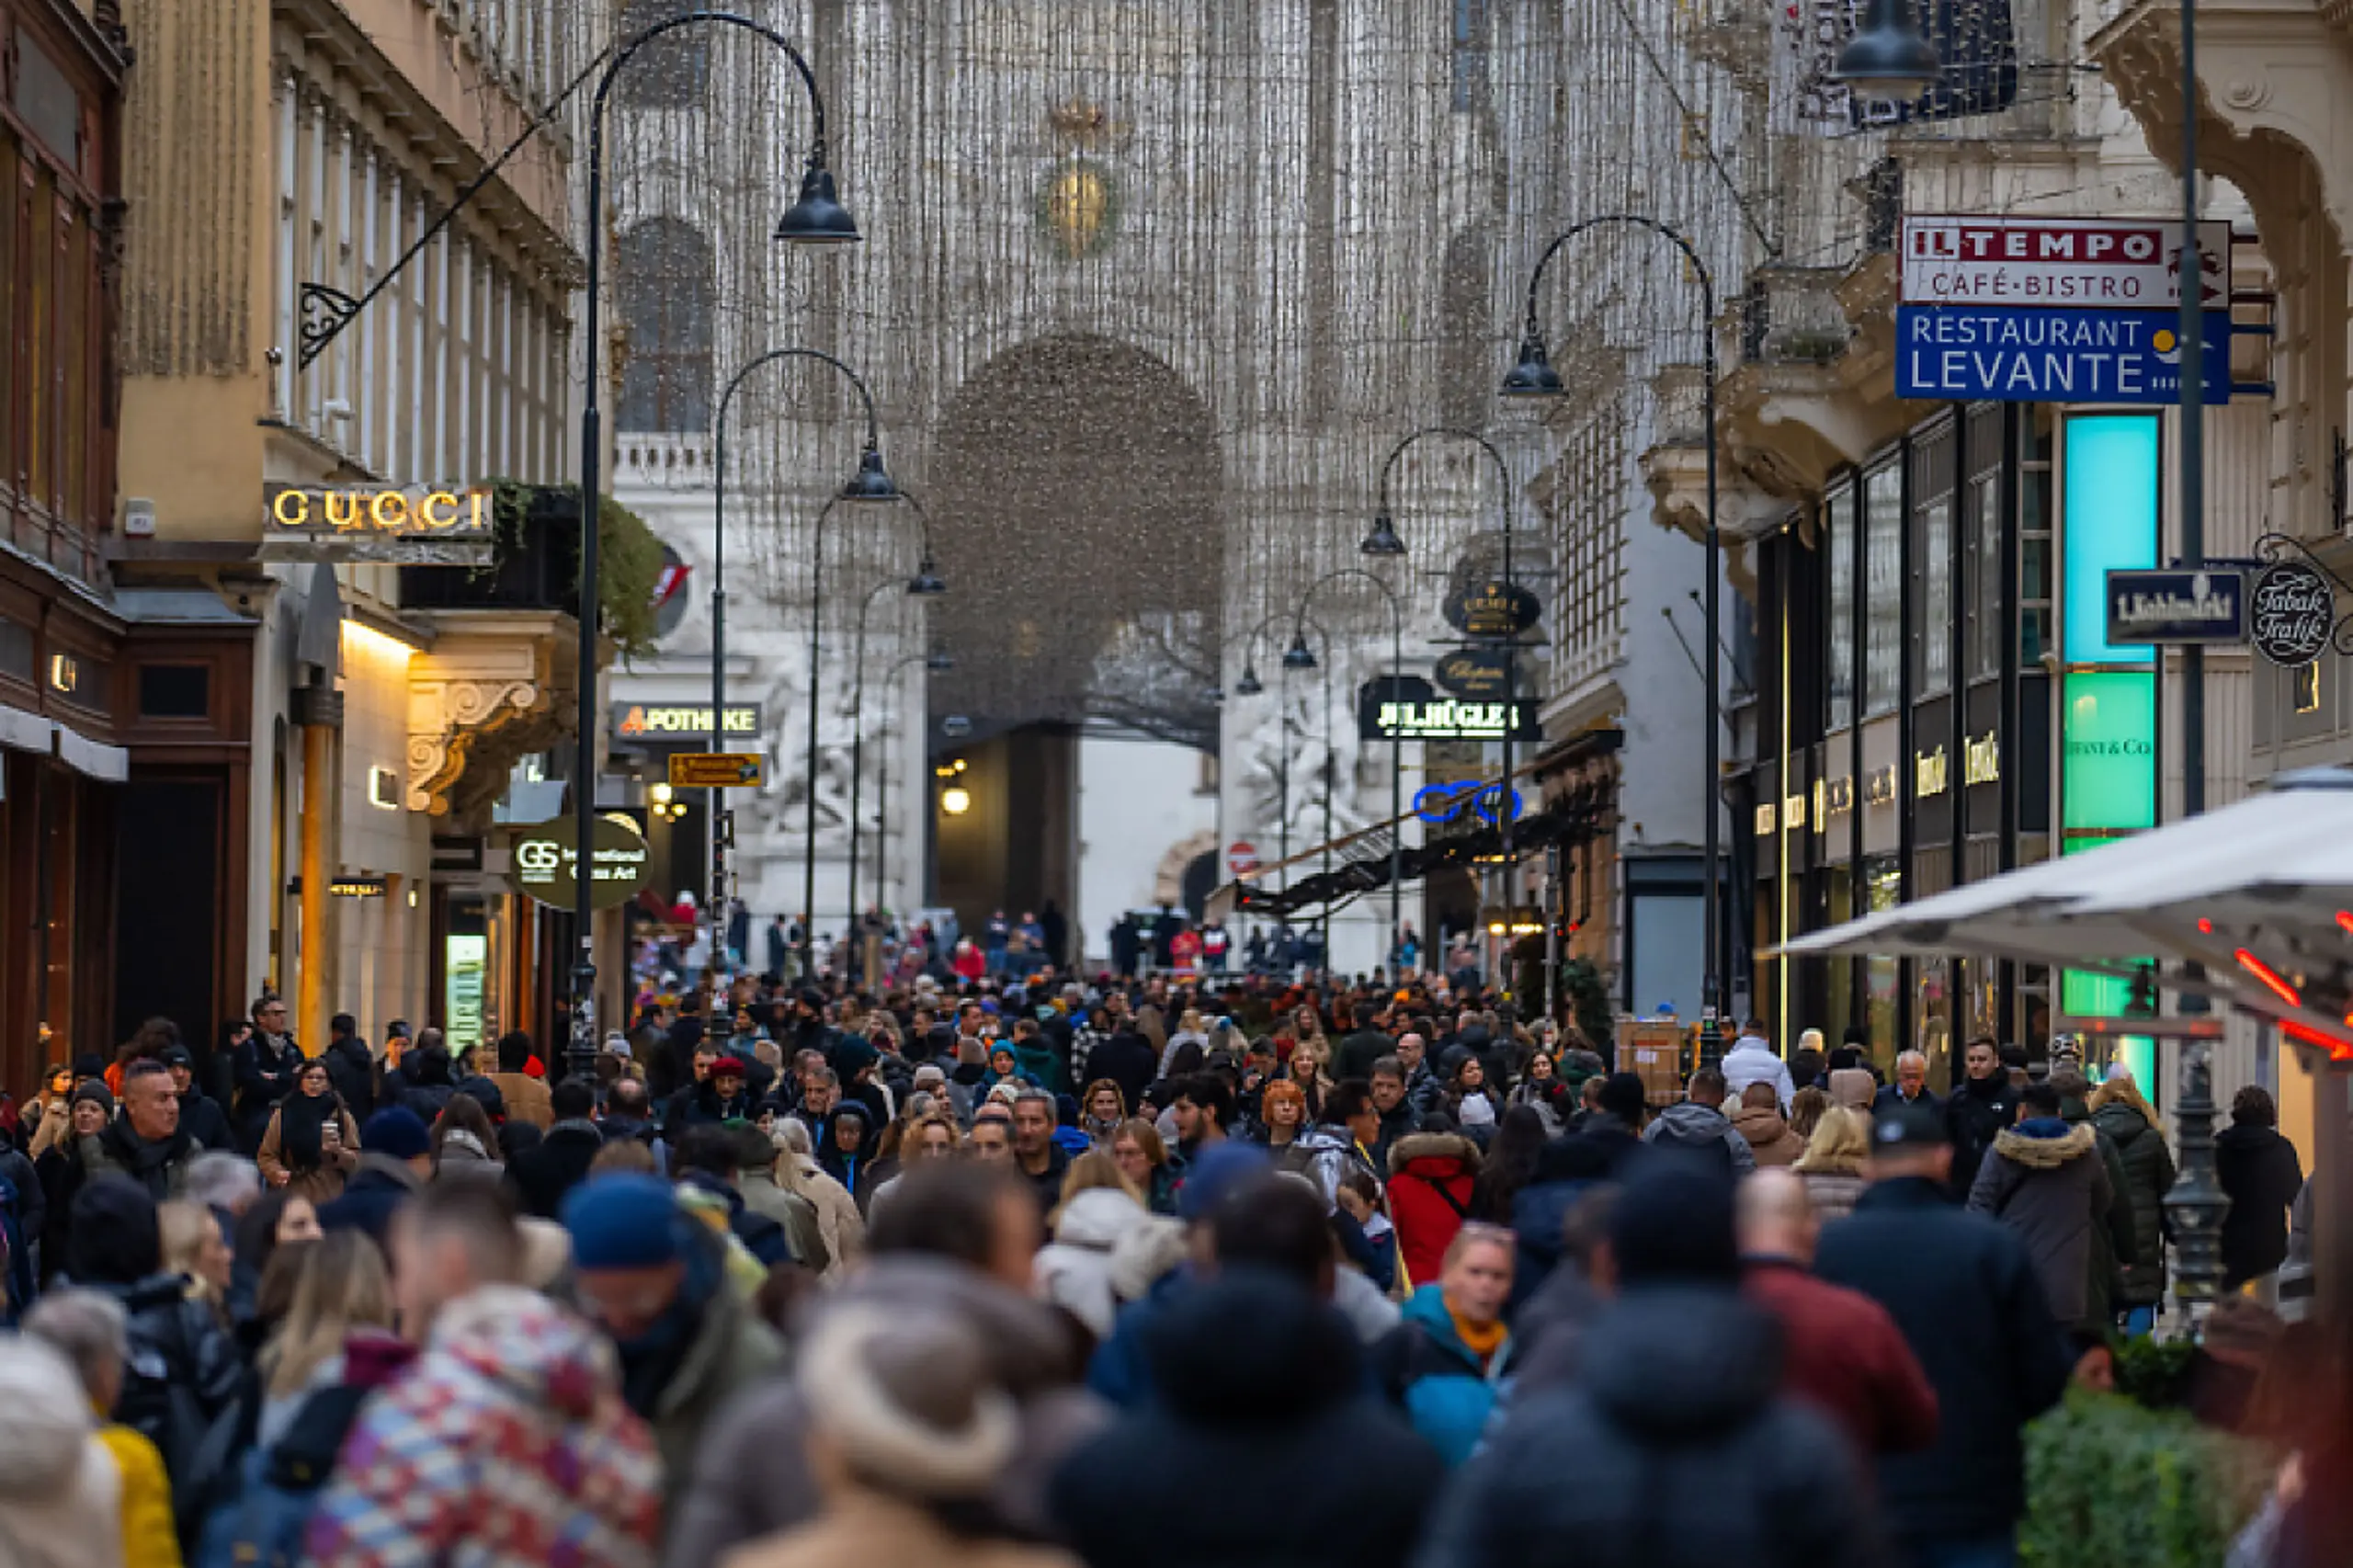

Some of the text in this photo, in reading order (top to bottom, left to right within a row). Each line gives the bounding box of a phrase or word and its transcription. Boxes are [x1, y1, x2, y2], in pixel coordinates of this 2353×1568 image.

[1965, 231, 2155, 260] TEMPO
[1912, 315, 2143, 347] RESTAURANT
[1911, 350, 2143, 394] LEVANTE
[273, 489, 483, 529] GUCCI
[2257, 613, 2326, 643] Trafik
[517, 841, 559, 869] GS
